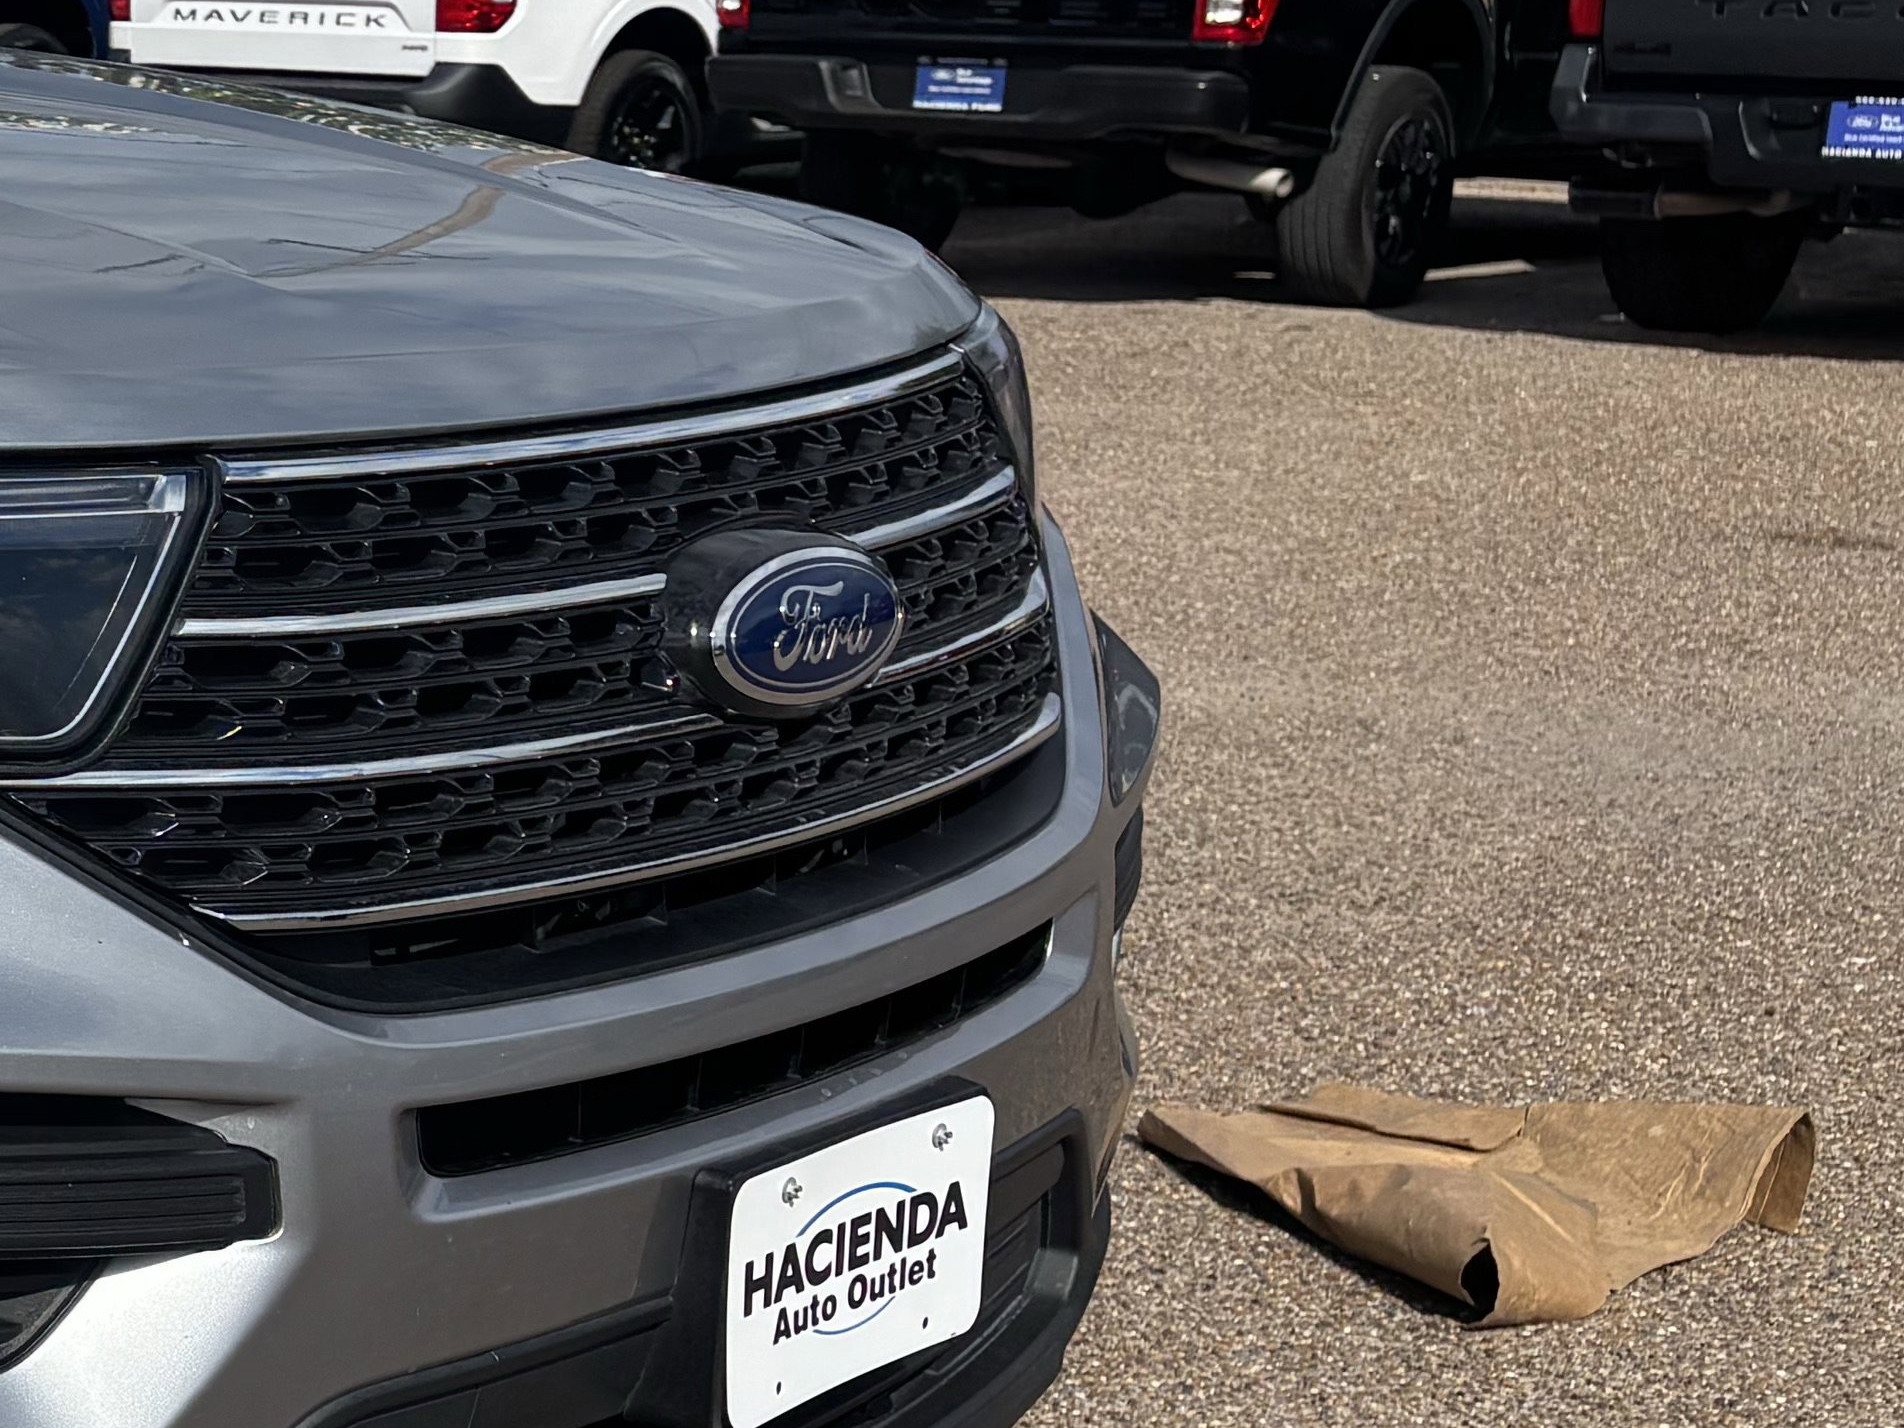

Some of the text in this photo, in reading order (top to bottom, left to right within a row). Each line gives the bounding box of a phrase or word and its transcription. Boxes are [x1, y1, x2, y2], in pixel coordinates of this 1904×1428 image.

[173, 7, 388, 28] MAVERICK
[773, 580, 874, 671] Ford
[743, 1180, 968, 1318] HACIENDA
[772, 1247, 937, 1345] Auto Outlet
